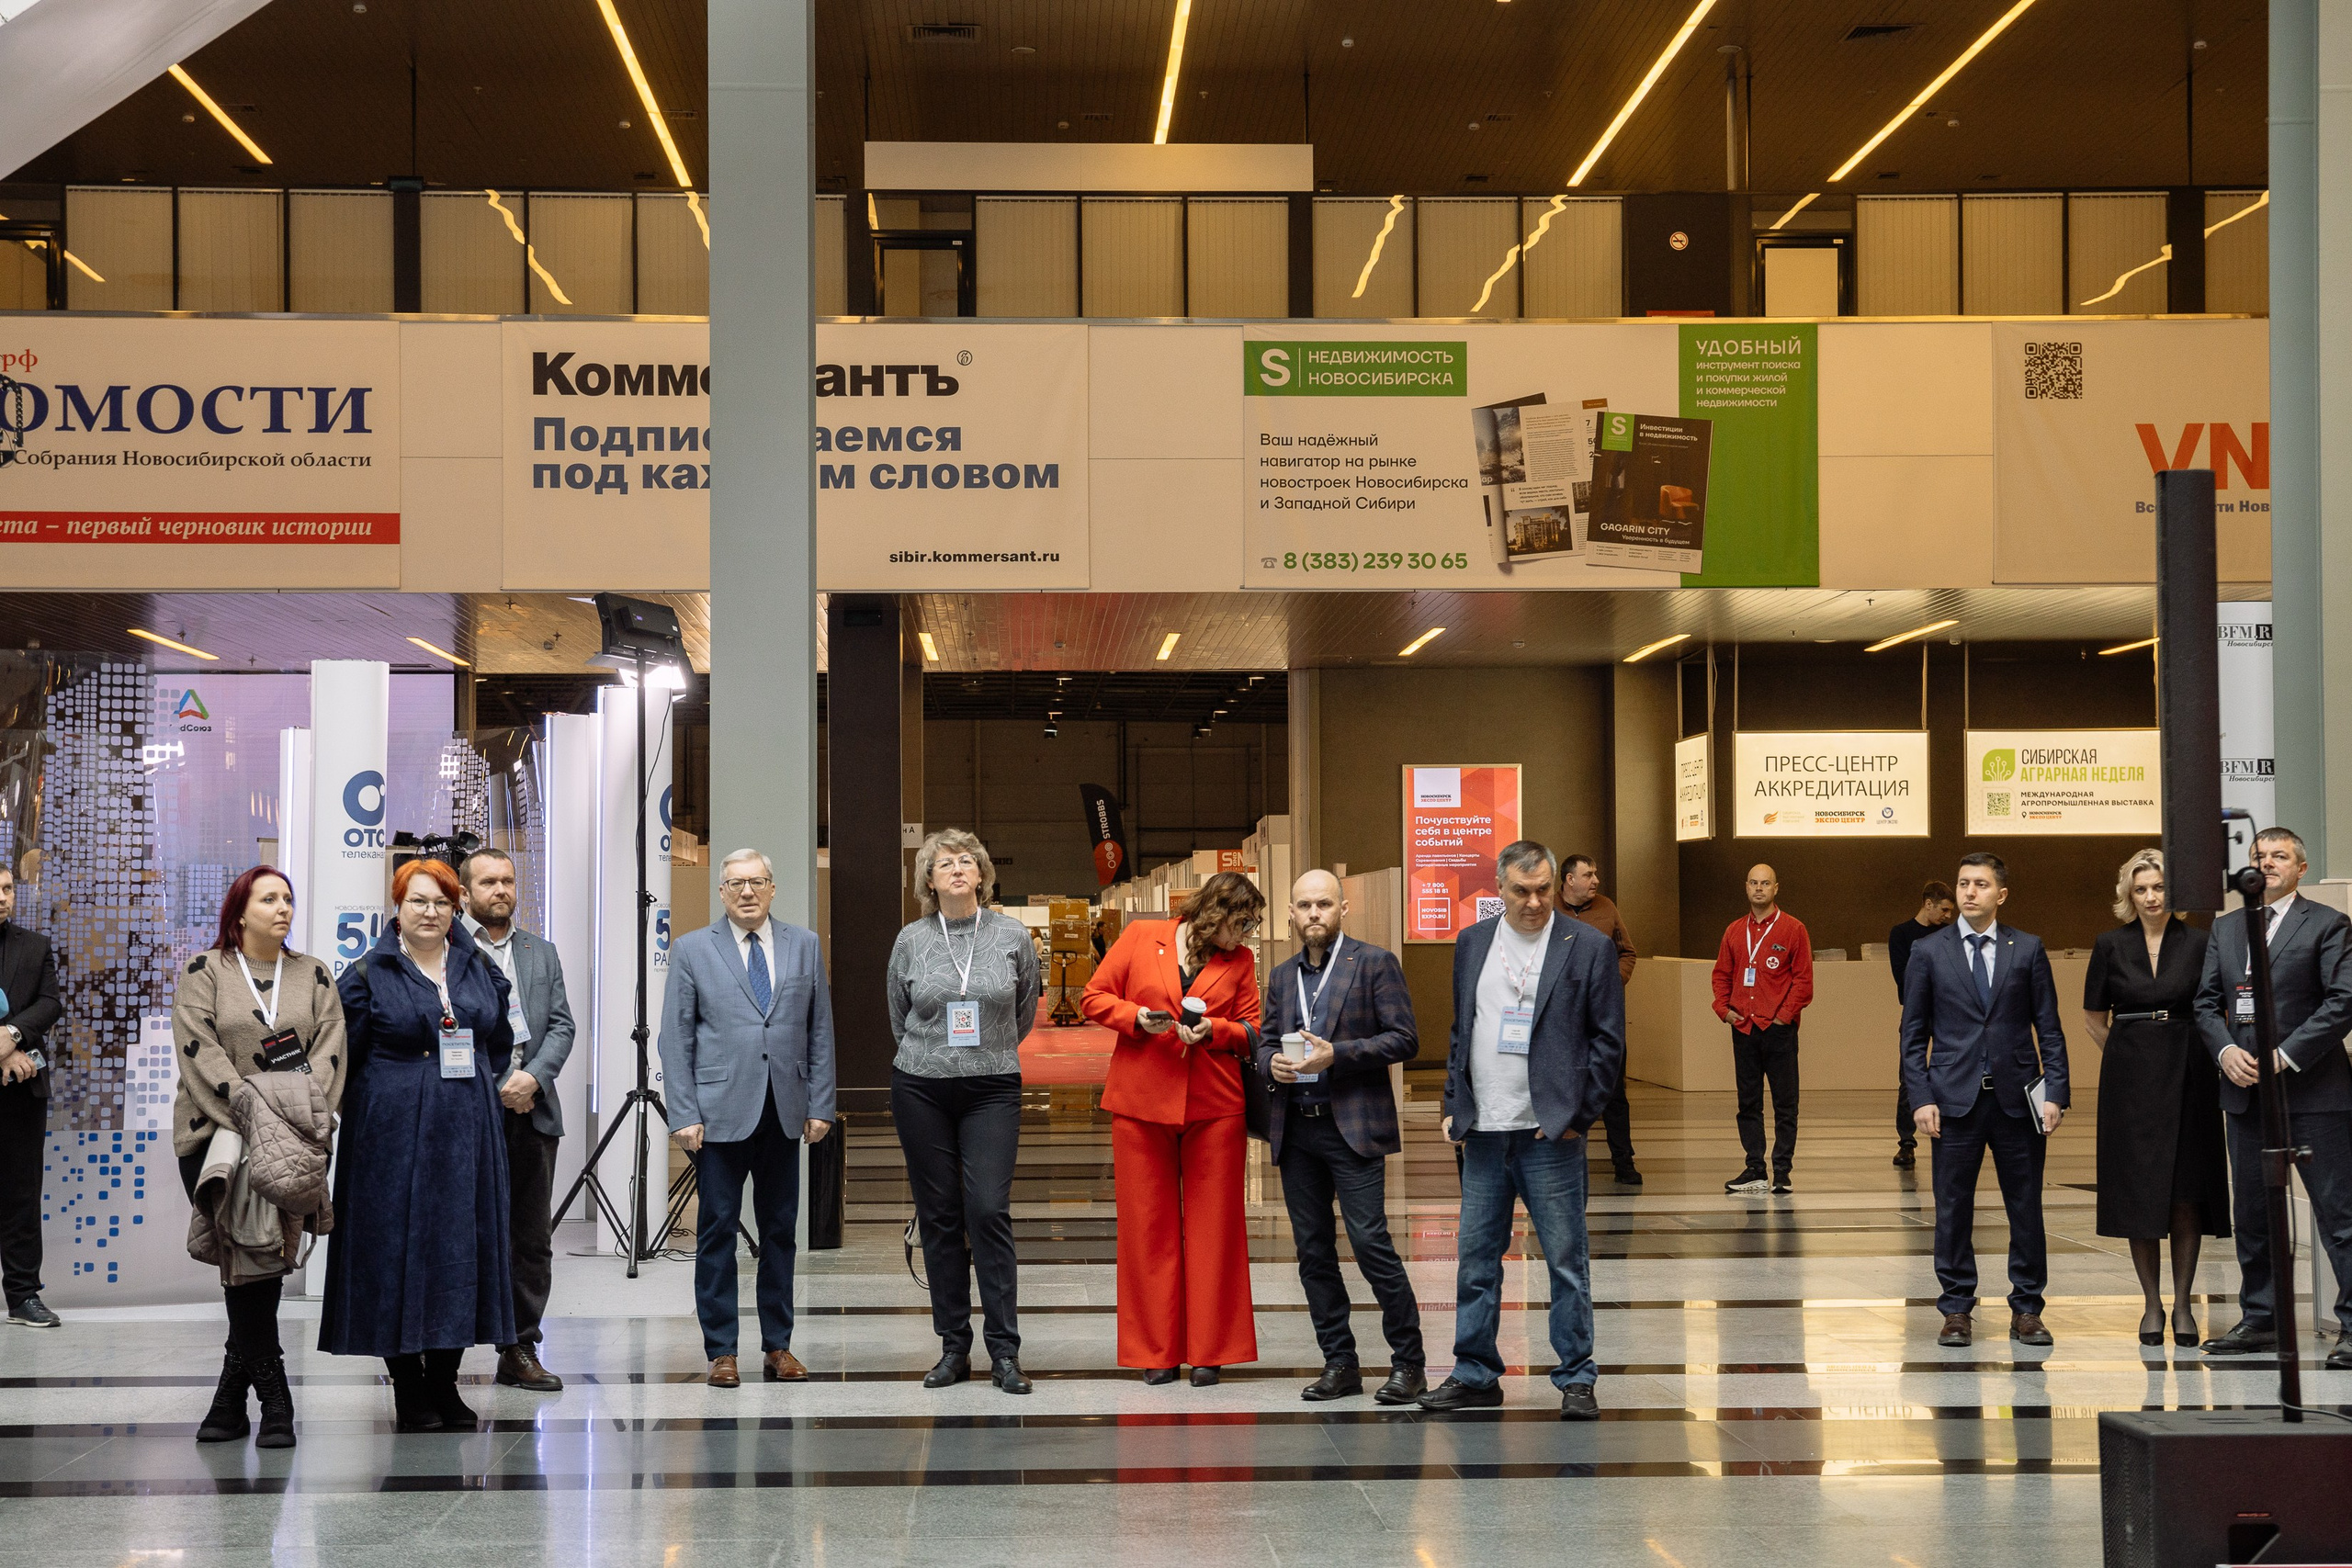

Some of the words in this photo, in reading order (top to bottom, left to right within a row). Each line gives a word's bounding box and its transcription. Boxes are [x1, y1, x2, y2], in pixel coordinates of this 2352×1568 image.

[1695, 335, 1801, 357] УДОБНЫЙ
[1308, 350, 1454, 366] НЕДВИЖИМОСТЬ
[1696, 361, 1759, 371] инструмент
[1761, 361, 1801, 369] поиска
[1308, 372, 1454, 386] НОВОСИБИРСКА
[1705, 375, 1750, 384] покупки
[1752, 372, 1788, 382] жилой
[1705, 385, 1786, 396] коммерческой
[1696, 399, 1777, 408] недвижимости
[1639, 423, 1683, 433] Инвестиции
[1260, 433, 1294, 446] Ваш
[1297, 434, 1379, 448] надёжный
[1645, 432, 1698, 442] недвижимость
[15, 449, 117, 469] Собрания
[122, 451, 285, 472] Новосибирской
[290, 451, 372, 467] области
[1260, 457, 1340, 470] навигатор
[1345, 457, 1364, 468] на
[1369, 457, 1418, 470] рынке
[533, 463, 628, 494] под
[869, 463, 1059, 490] словом
[1260, 477, 1351, 491] новостроек
[1355, 476, 1469, 491] Новосибирска
[1260, 499, 1270, 509] и
[1274, 496, 1351, 511] Западной
[1355, 496, 1416, 512] Сибири
[0, 519, 38, 535] та
[66, 517, 152, 539] первый
[159, 521, 266, 540] черновик
[272, 521, 372, 540] истории
[1600, 523, 1646, 535] GAGARIN
[1647, 524, 1670, 536] CITY
[1622, 535, 1659, 544] Уверенность
[888, 551, 1060, 563] sibir.kommersant.ru
[1283, 552, 1297, 570] 8
[1302, 551, 1359, 572] (383)
[1363, 552, 1404, 570] 239
[1408, 552, 1437, 570] 30
[1441, 552, 1468, 570] 65
[2218, 624, 2272, 640] BFM.R
[2021, 749, 2098, 764] СИБИРСКАЯ
[1765, 755, 1898, 775] ПРЕСС-ЦЕНТР
[2221, 759, 2275, 775] BFM.R
[2020, 766, 2087, 782] АГРАРНАЯ
[2091, 766, 2144, 783] НЕДЕЛЯ
[1754, 780, 1909, 800] АККРЕДИТАЦИЯ
[1096, 799, 1111, 840] STROBBS
[1415, 815, 1492, 827] Почувствуйте
[1415, 827, 1441, 835] себя
[1453, 829, 1492, 837] центре
[1415, 838, 1464, 847] событий
